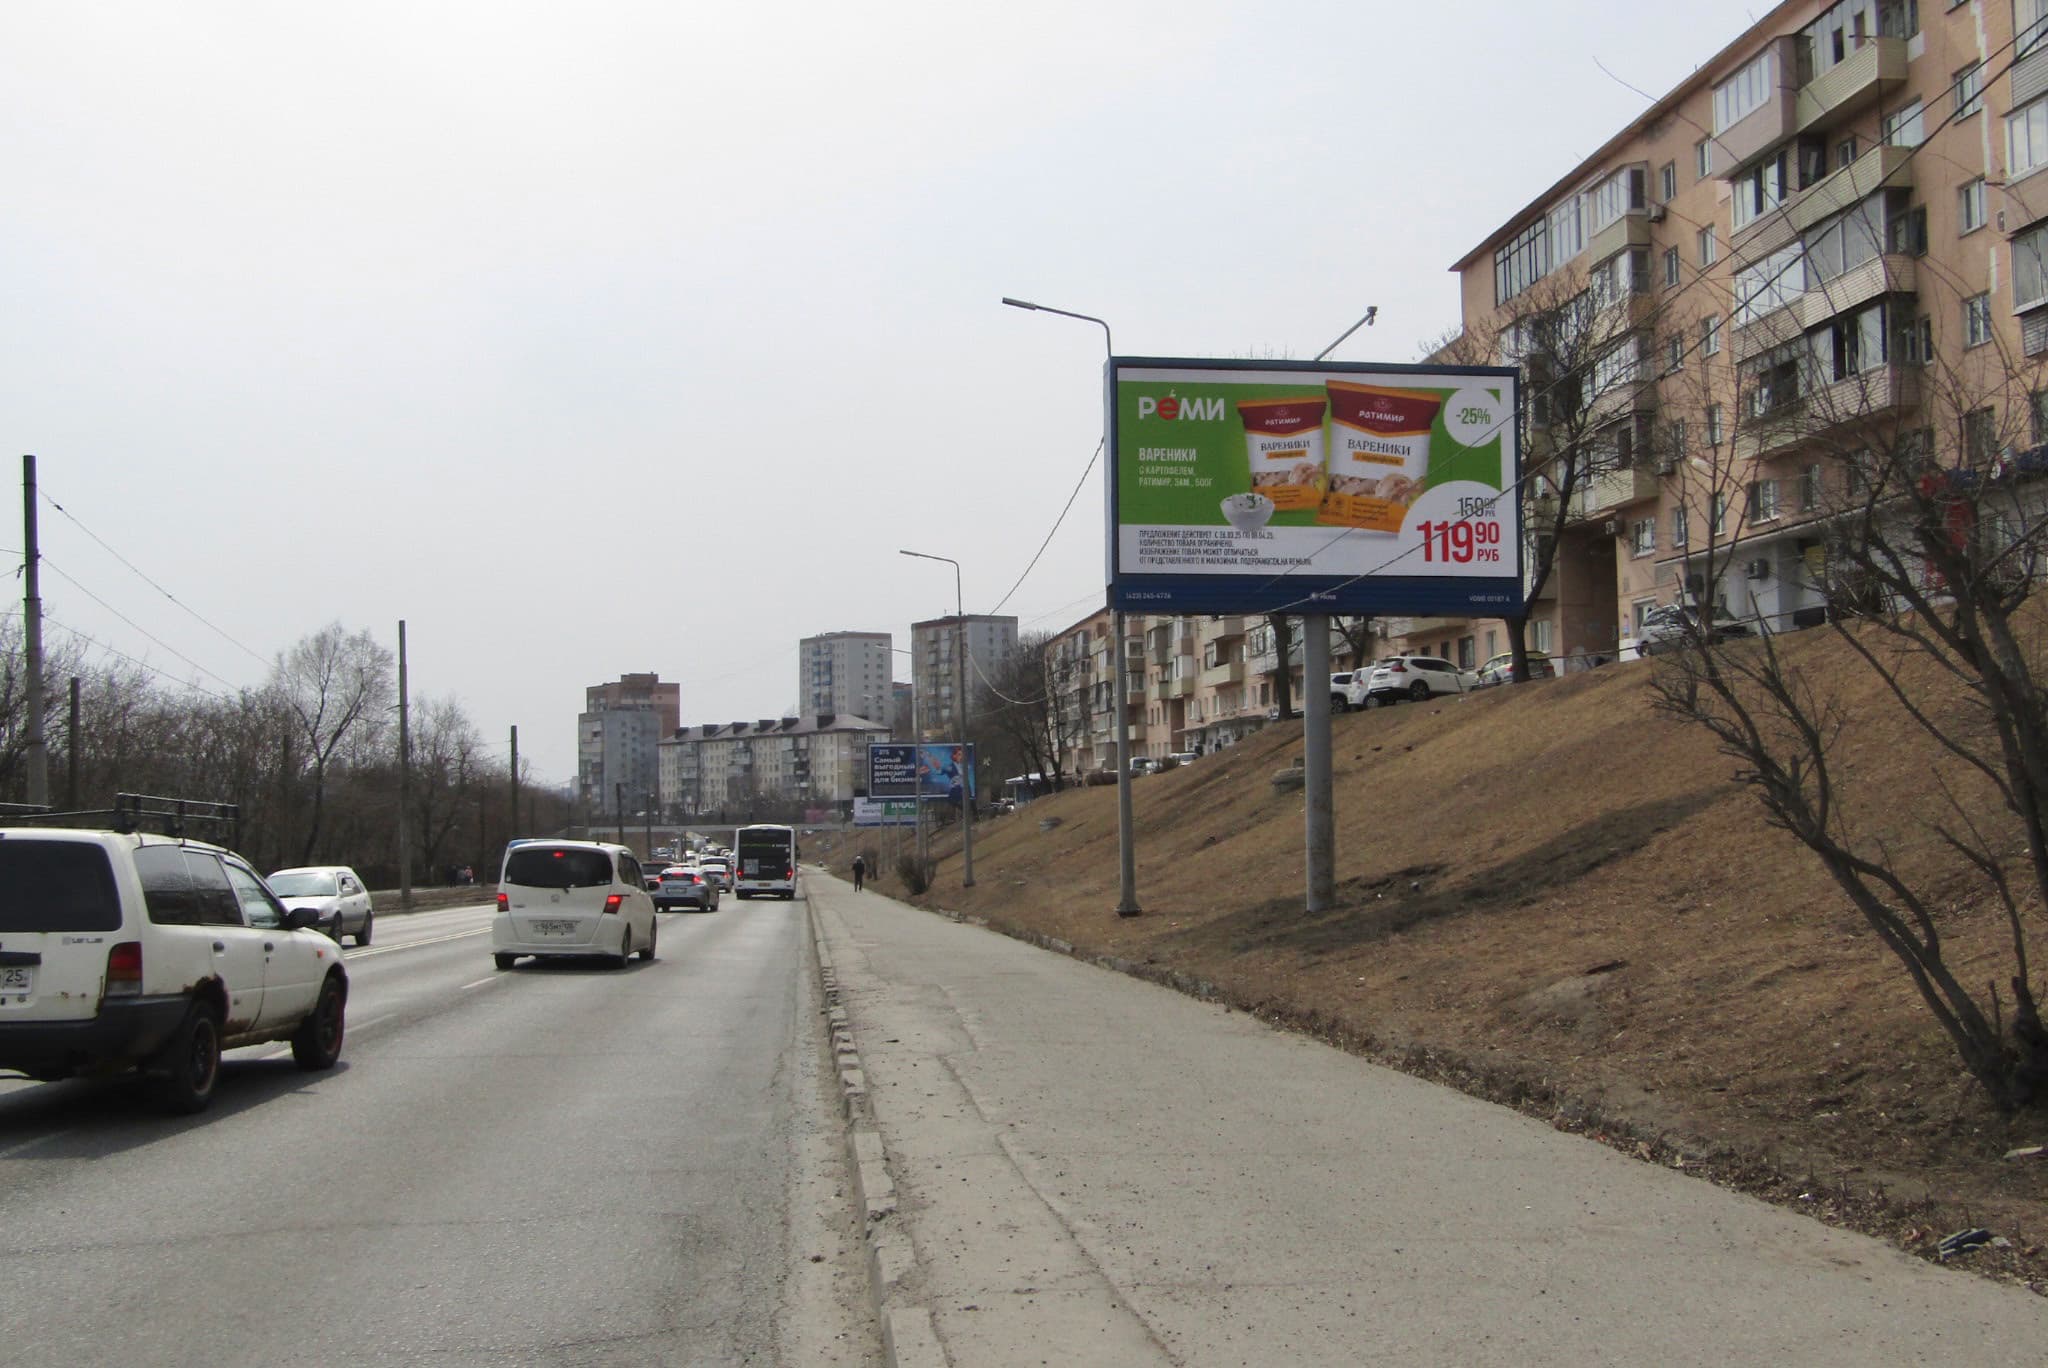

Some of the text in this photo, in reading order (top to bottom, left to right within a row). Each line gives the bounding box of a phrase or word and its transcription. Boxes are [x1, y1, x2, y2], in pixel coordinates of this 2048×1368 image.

[1456, 407, 1491, 425] -25%
[1260, 440, 1311, 452] ВАРЕНИКИ
[1346, 438, 1411, 457] ВАРЕНИКИ
[1138, 447, 1197, 462] ВАРЕНИКИ
[1416, 520, 1500, 563] 119 90
[1203, 548, 1223, 556] МОЖЕТ
[1477, 549, 1500, 562] РУБ
[5, 968, 24, 983] 25
